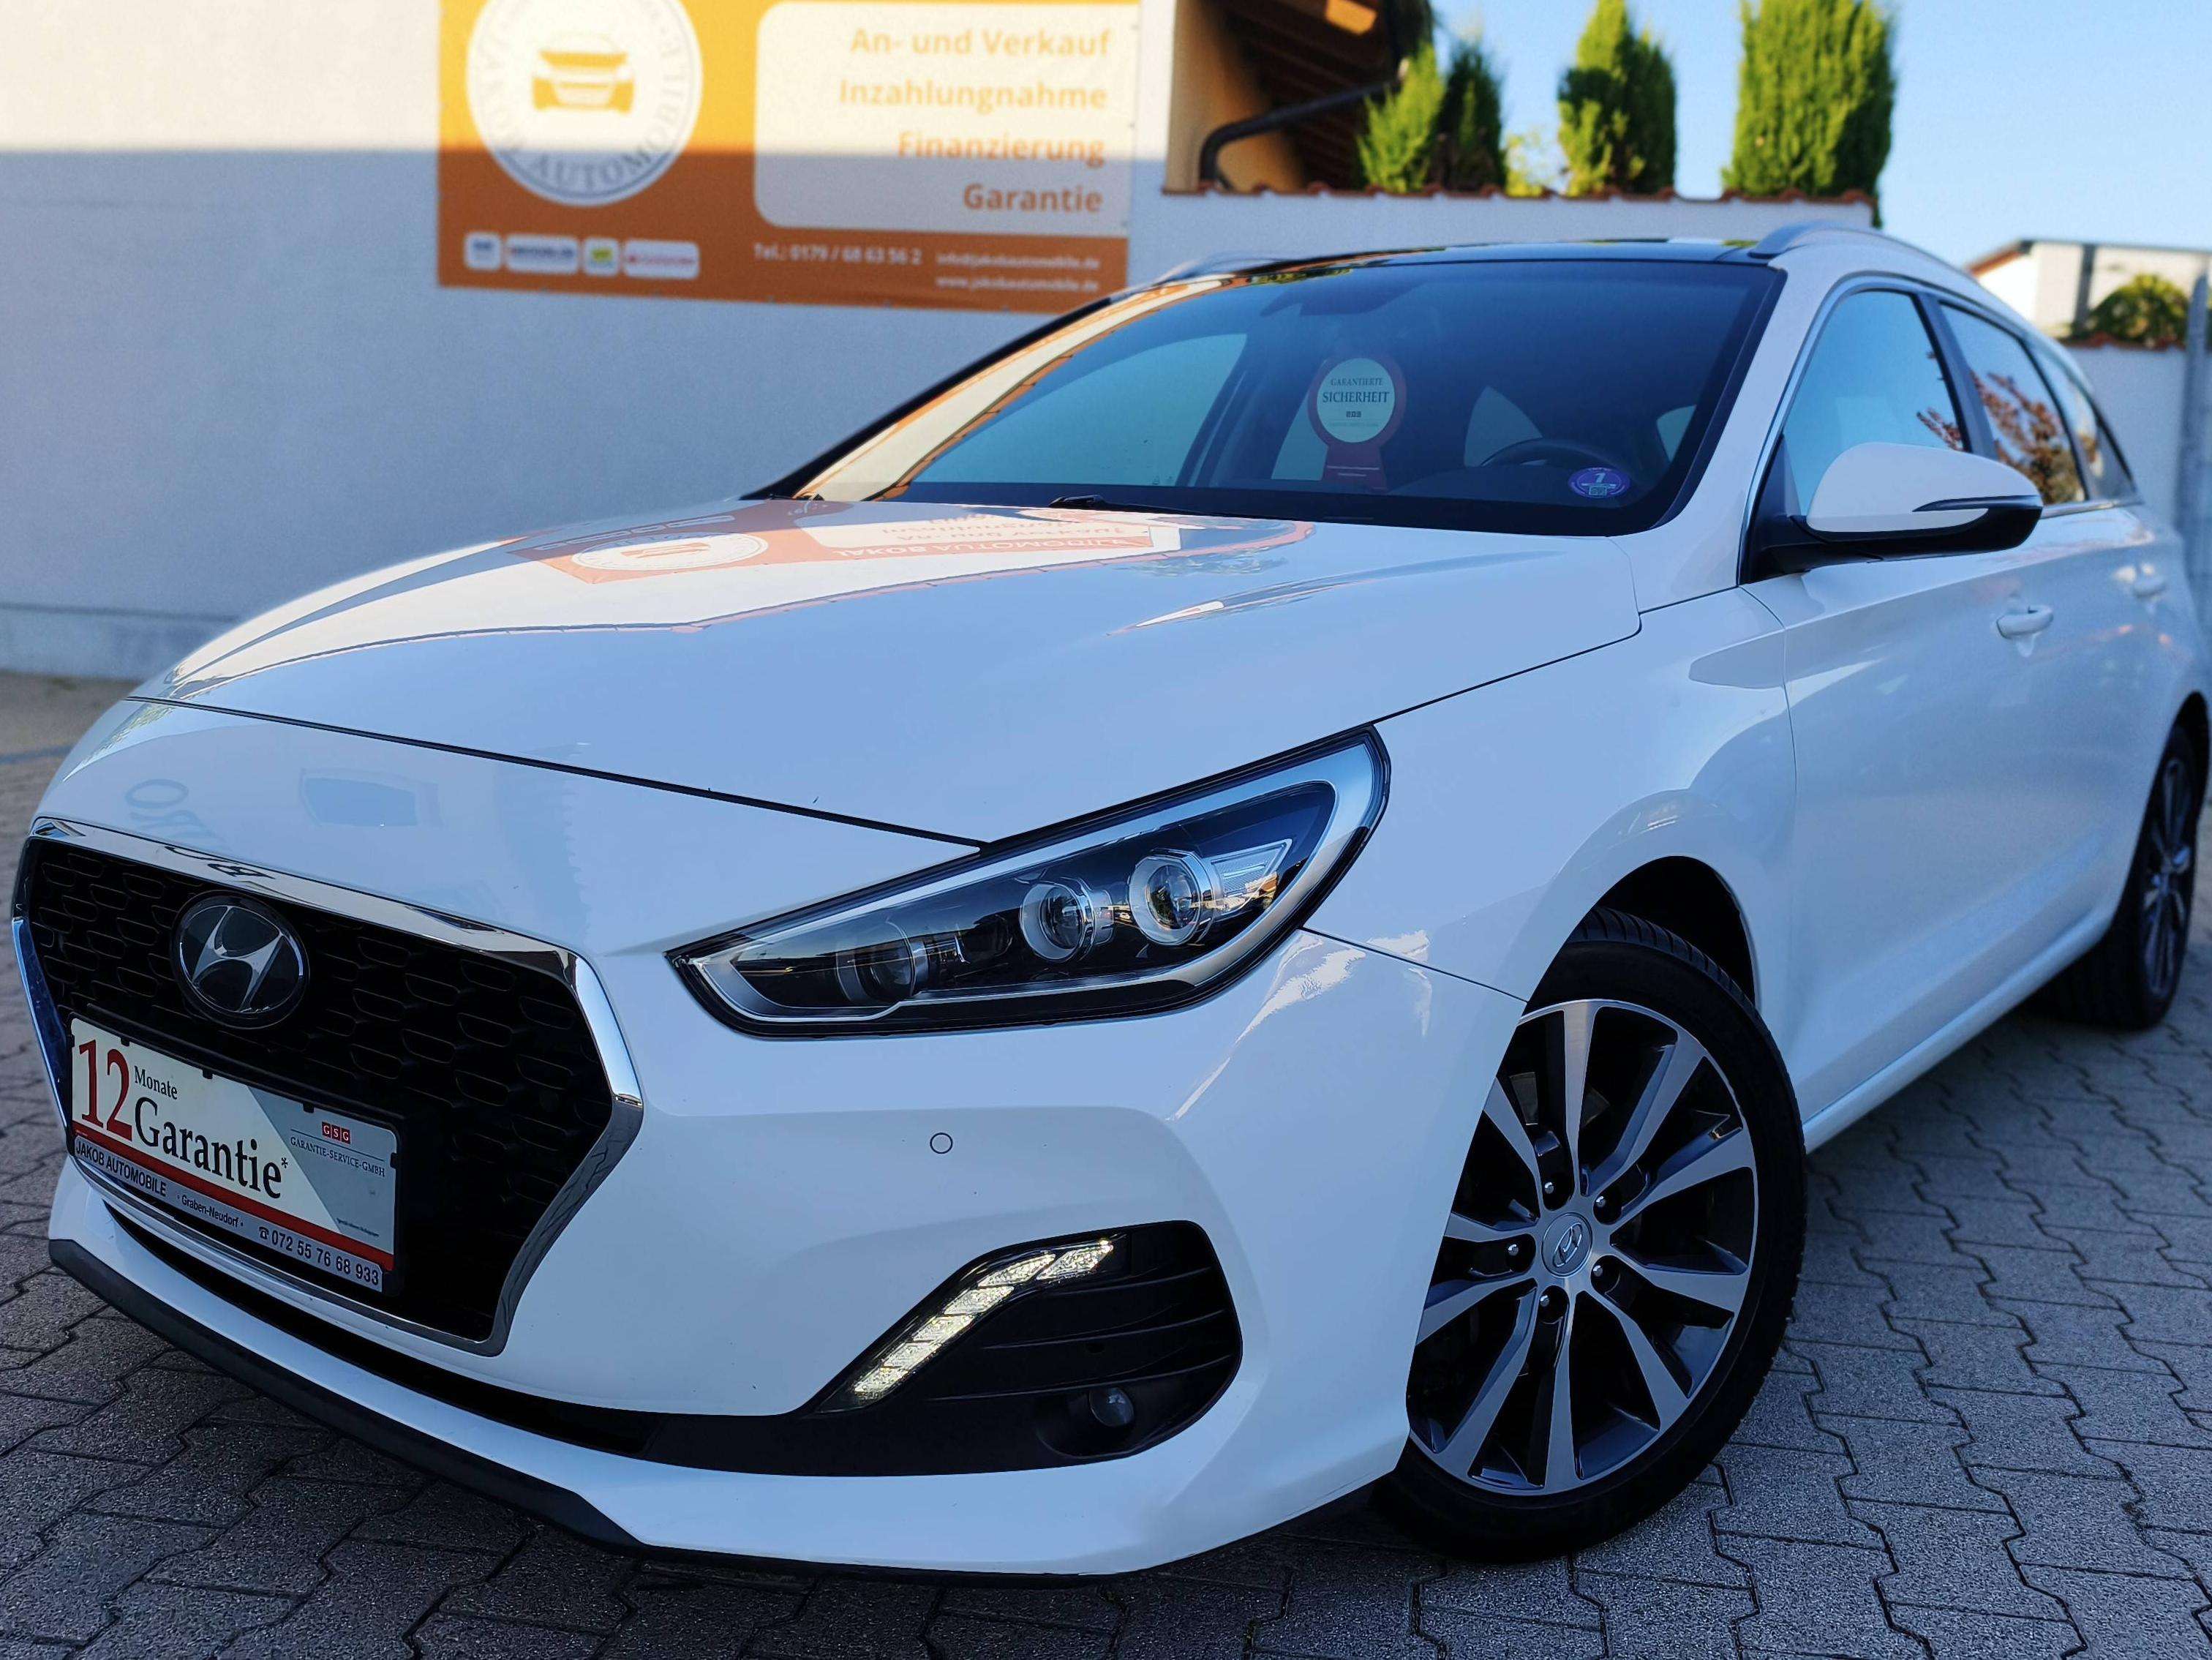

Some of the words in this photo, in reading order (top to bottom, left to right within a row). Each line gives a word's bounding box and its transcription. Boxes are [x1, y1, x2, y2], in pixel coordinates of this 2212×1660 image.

[850, 28, 902, 56] An-
[912, 29, 972, 56] und
[982, 29, 1111, 56] Verkauf
[840, 79, 1108, 114] Inzahlungnahme
[898, 130, 1105, 168] Finanzierung
[963, 182, 1103, 213] Garantie
[1323, 391, 1389, 404] SICHERHEIT
[1330, 378, 1382, 387] GARANTIERTE
[79, 1040, 132, 1142] 12
[134, 1065, 178, 1100] Monate
[323, 1123, 350, 1143] GSG
[76, 1141, 105, 1165] JAKOB
[106, 1156, 167, 1198] AUTOMOBILE
[181, 1194, 240, 1228] Graben-Neudorf
[271, 1230, 293, 1252] 072
[297, 1240, 312, 1259] 55
[317, 1247, 331, 1267] 76
[336, 1255, 351, 1275] 68
[356, 1263, 380, 1286] 933
